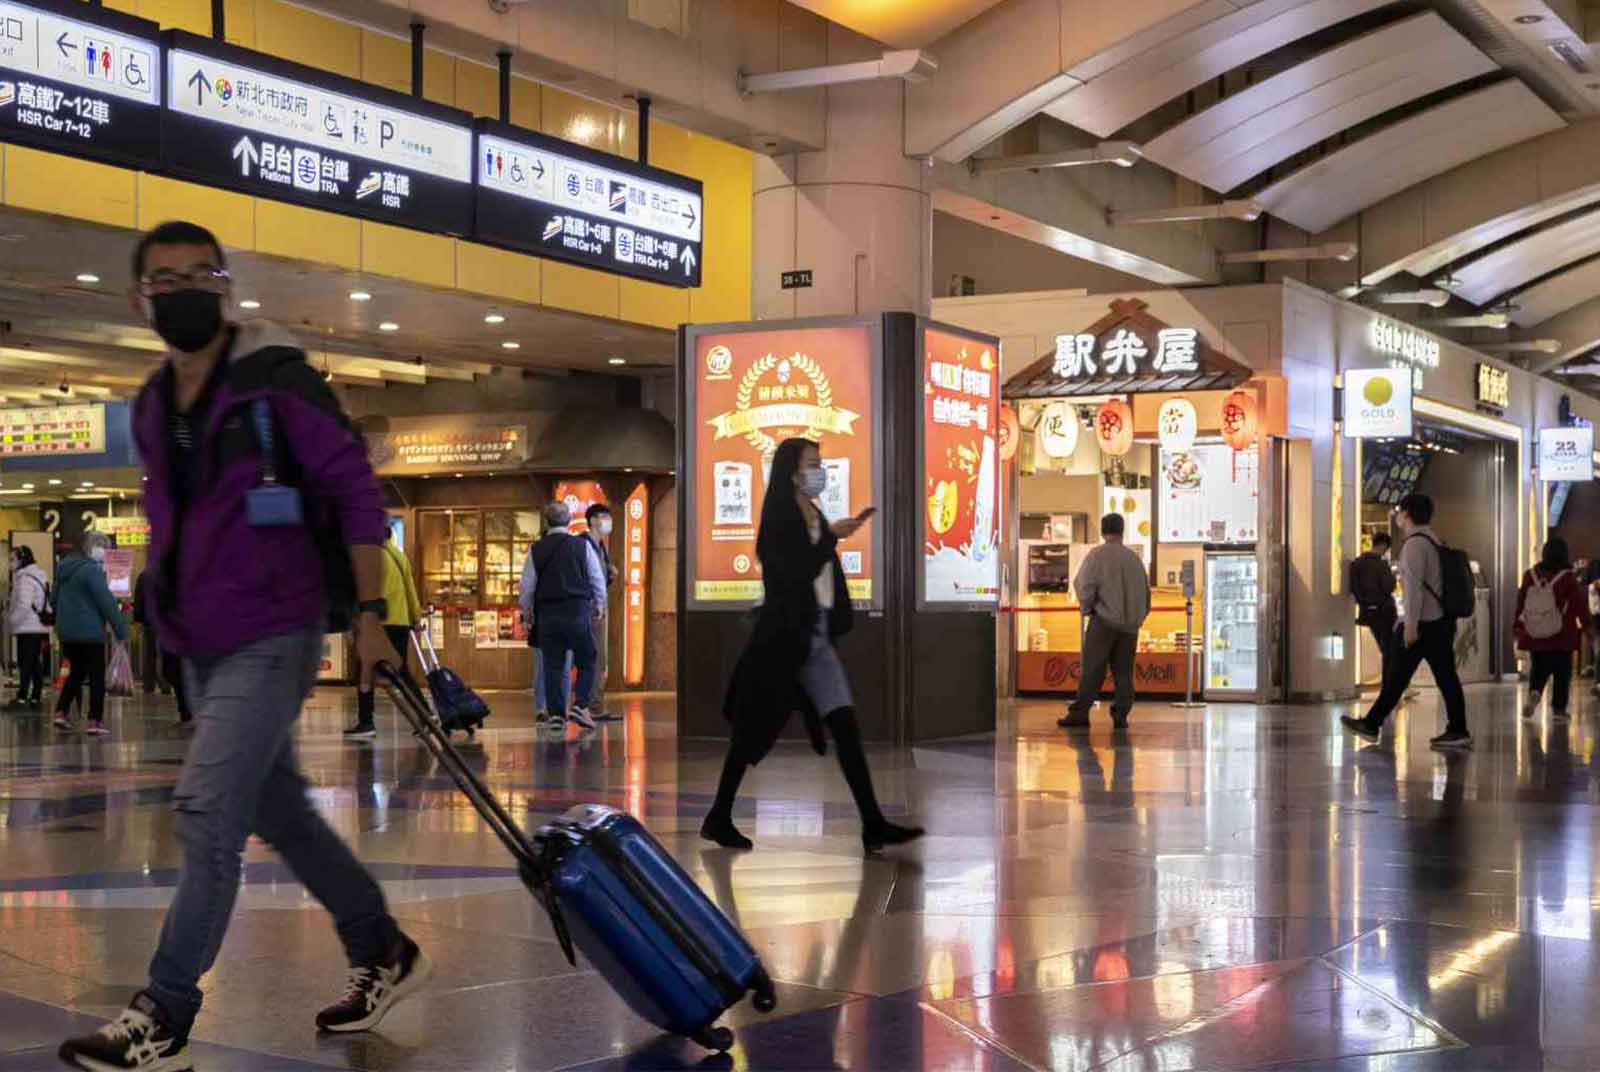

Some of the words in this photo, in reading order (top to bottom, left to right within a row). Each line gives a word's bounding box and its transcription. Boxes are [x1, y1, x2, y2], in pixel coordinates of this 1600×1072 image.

[236, 80, 308, 119] 新北市政府
[17, 109, 43, 127] HSR
[44, 115, 64, 131] Car
[260, 141, 293, 173] 月台
[320, 179, 340, 195] TRA
[382, 193, 401, 208] HSR
[1052, 328, 1200, 377] 駅弁屋
[1360, 408, 1395, 418] GOLD
[1044, 413, 1067, 439] 便
[1555, 440, 1577, 451] 22
